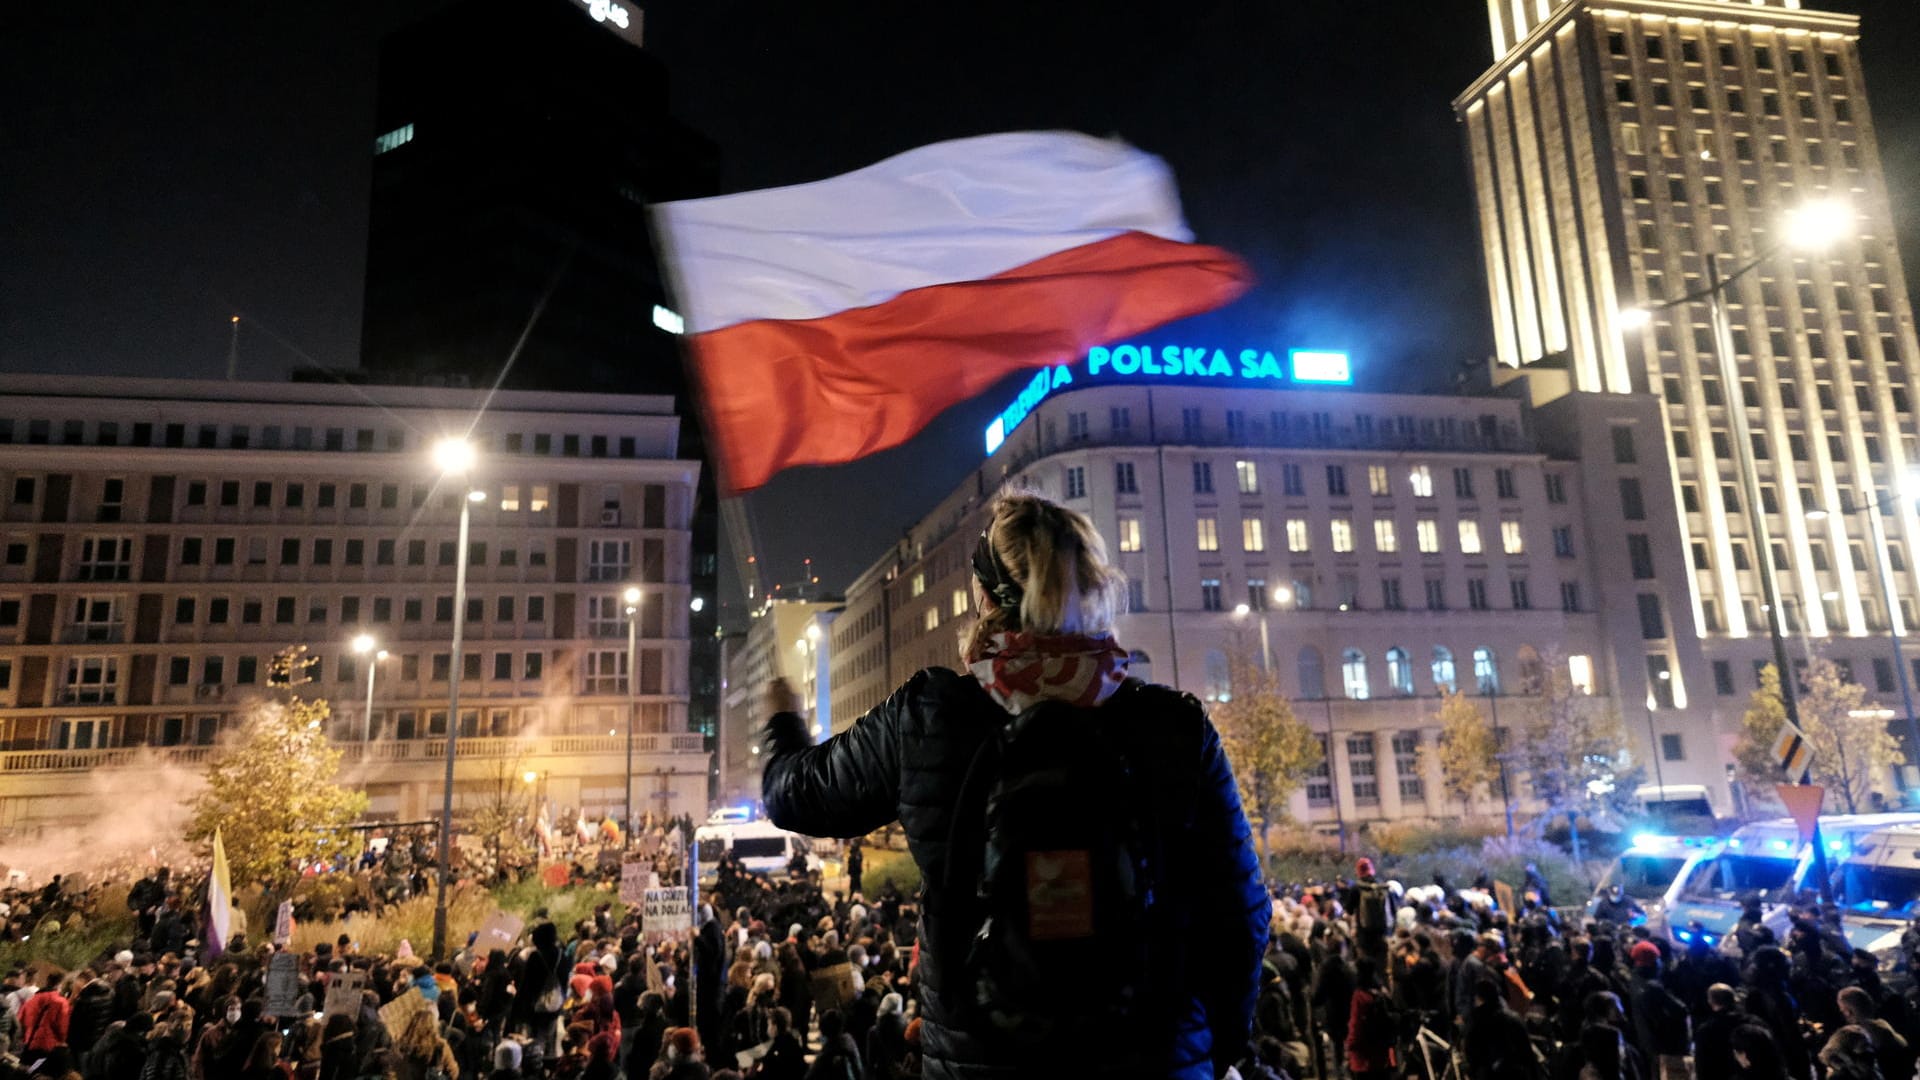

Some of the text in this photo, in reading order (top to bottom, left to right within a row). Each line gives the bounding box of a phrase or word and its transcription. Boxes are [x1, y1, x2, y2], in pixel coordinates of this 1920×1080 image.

[582, 0, 629, 29] gus
[1088, 344, 1233, 377] POLSKA
[1241, 350, 1282, 379] SA
[646, 891, 658, 902] NA
[645, 904, 658, 916] NA
